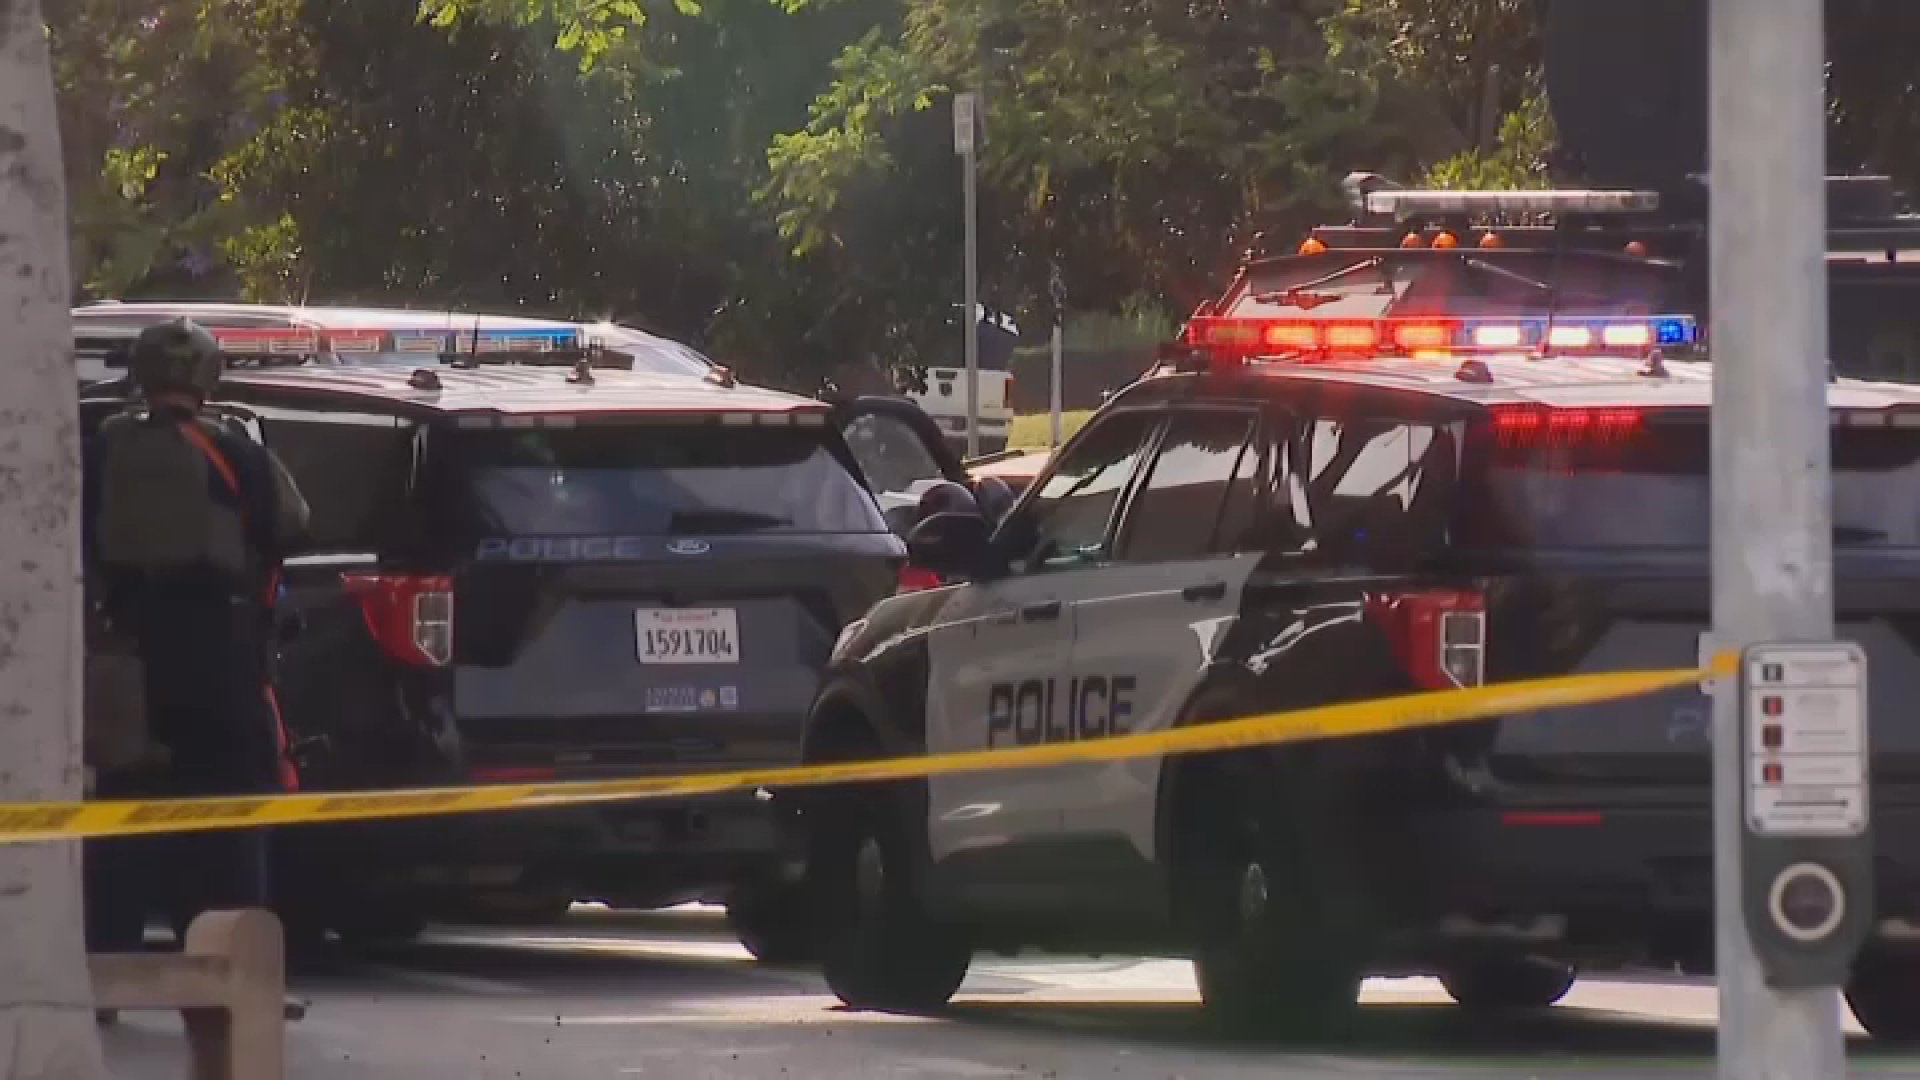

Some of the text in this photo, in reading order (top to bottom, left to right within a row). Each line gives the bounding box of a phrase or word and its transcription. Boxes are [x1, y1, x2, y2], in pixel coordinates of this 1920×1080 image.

[477, 537, 641, 560] POLICE
[644, 628, 732, 657] 1591704
[987, 675, 1137, 750] POLICE
